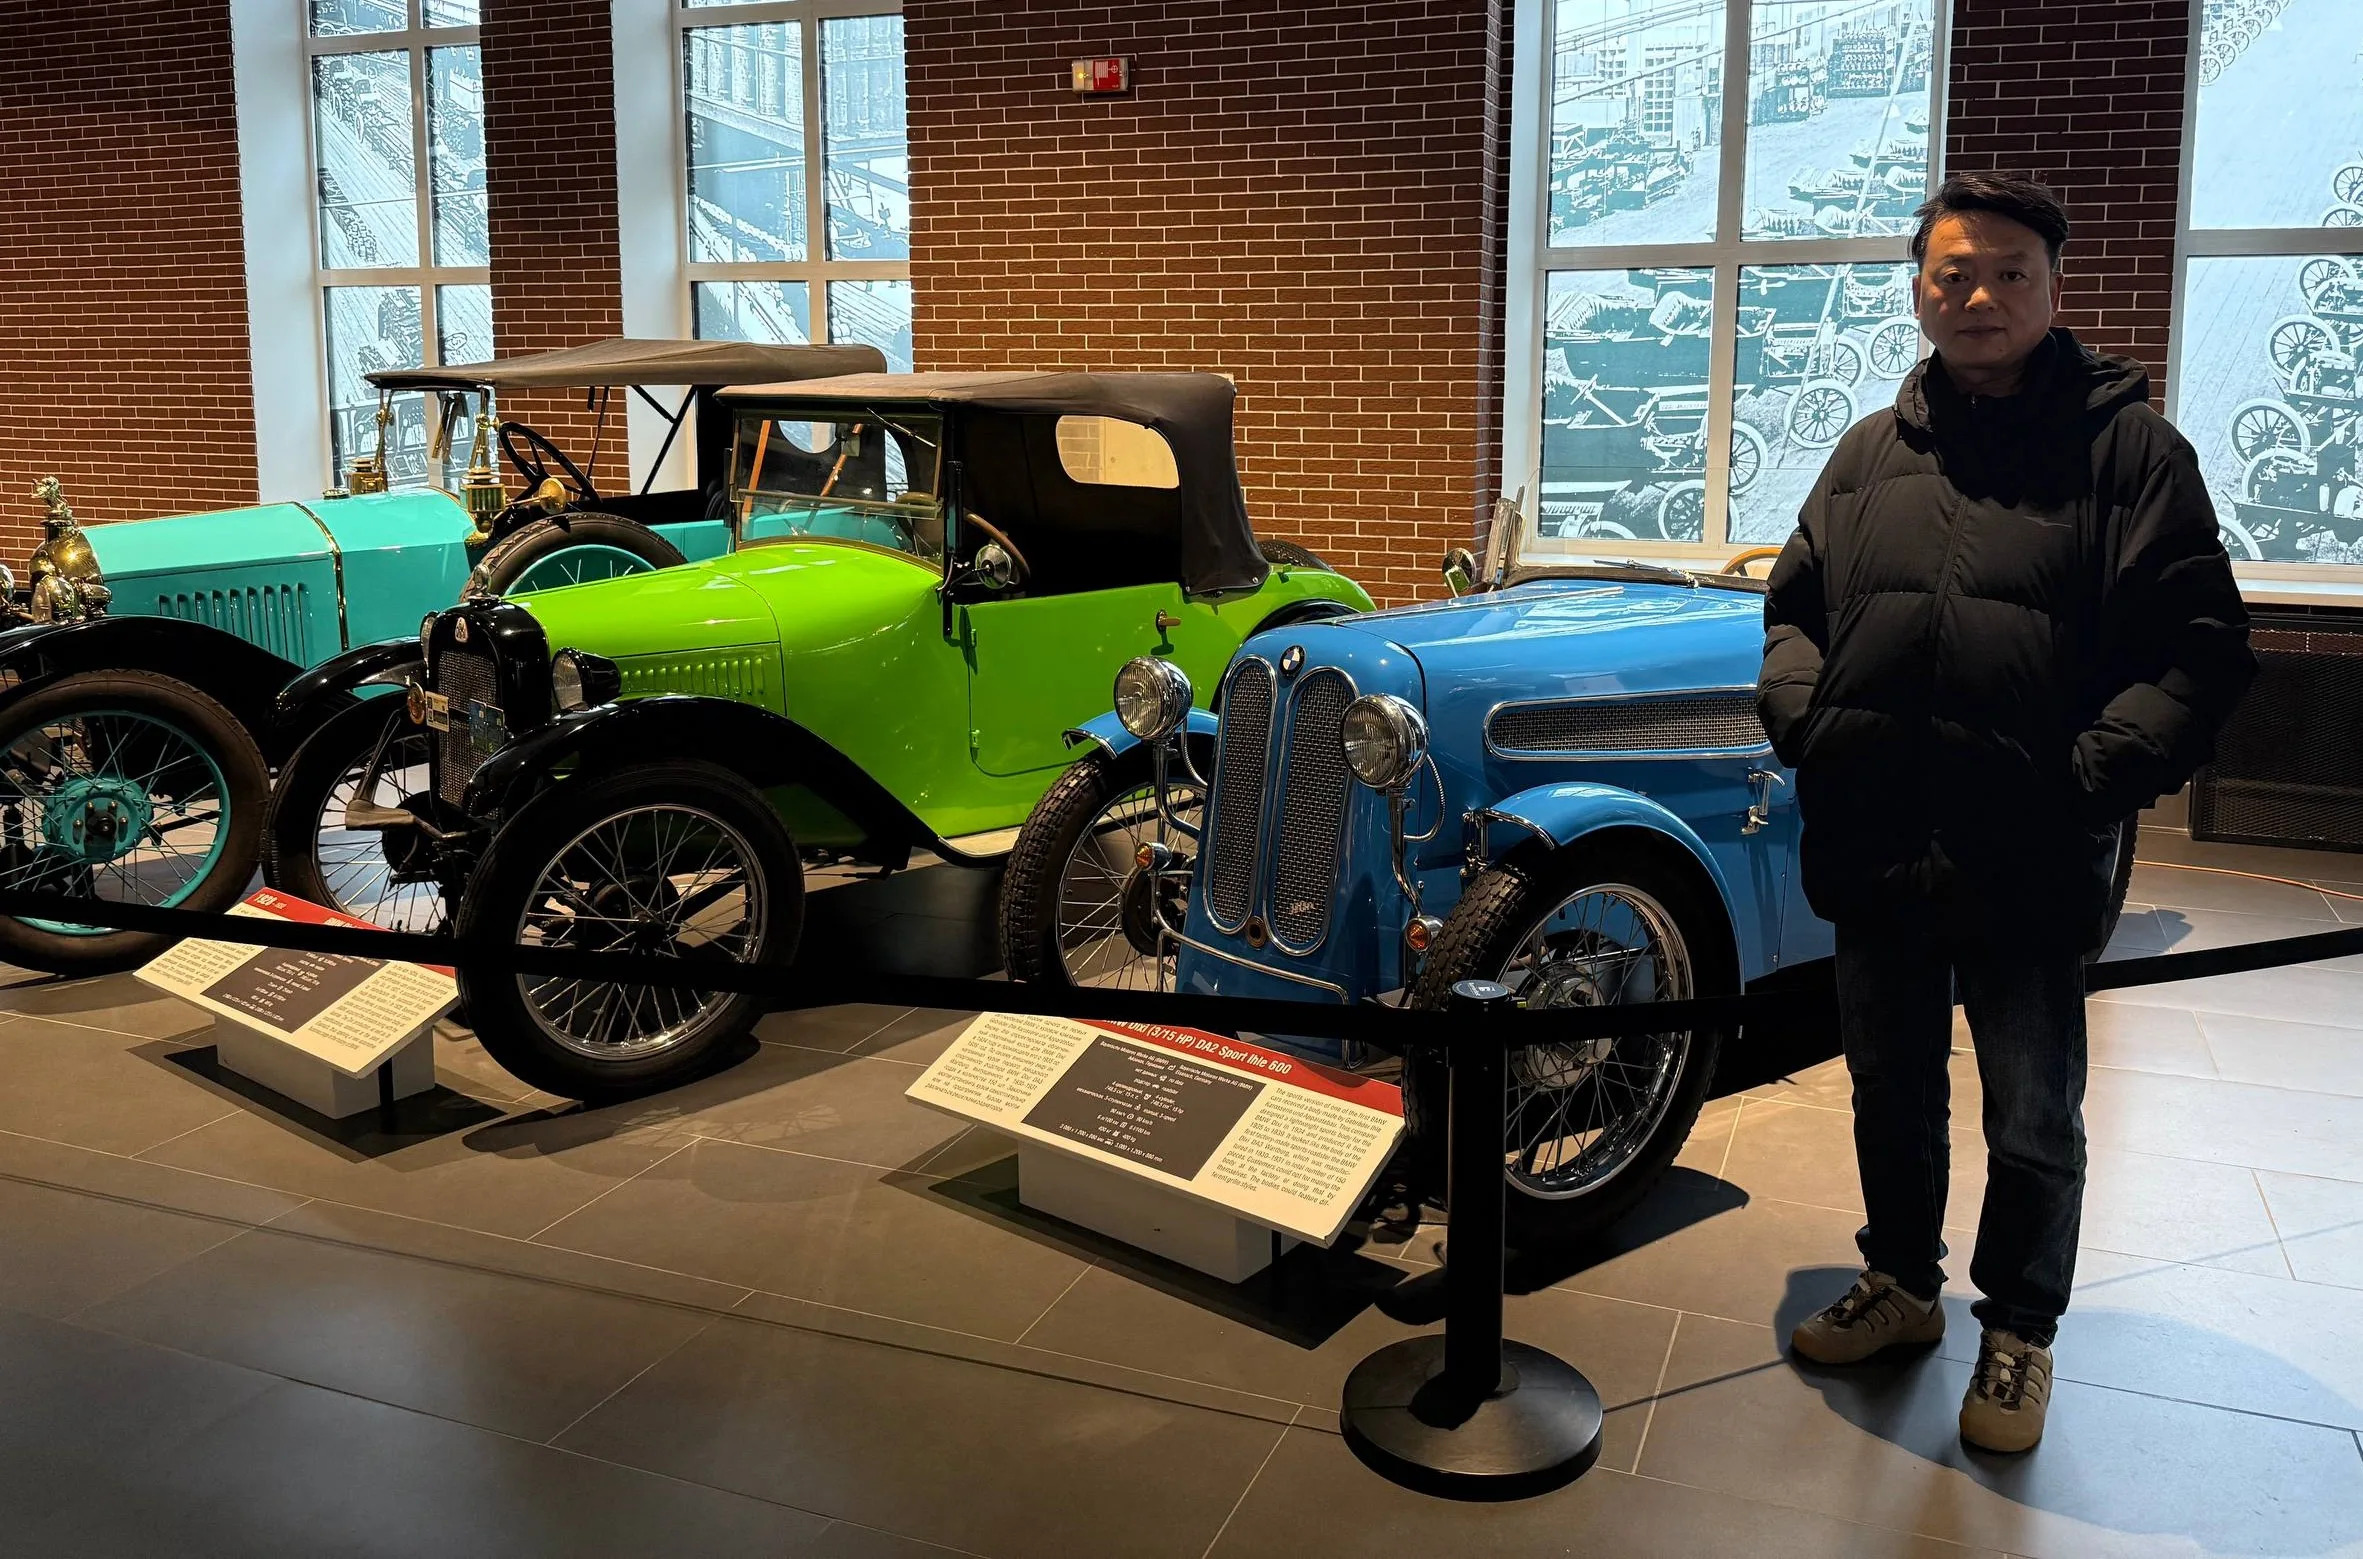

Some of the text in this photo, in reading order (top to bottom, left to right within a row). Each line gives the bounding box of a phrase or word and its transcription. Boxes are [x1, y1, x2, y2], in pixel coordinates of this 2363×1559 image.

[1145, 1024, 1178, 1042] (3/15
[1172, 1032, 1198, 1048] HP)
[1194, 1038, 1221, 1053] DA2
[1217, 1045, 1249, 1061] Sport
[1245, 1053, 1270, 1067] Ihle
[1266, 1059, 1294, 1074] 600
